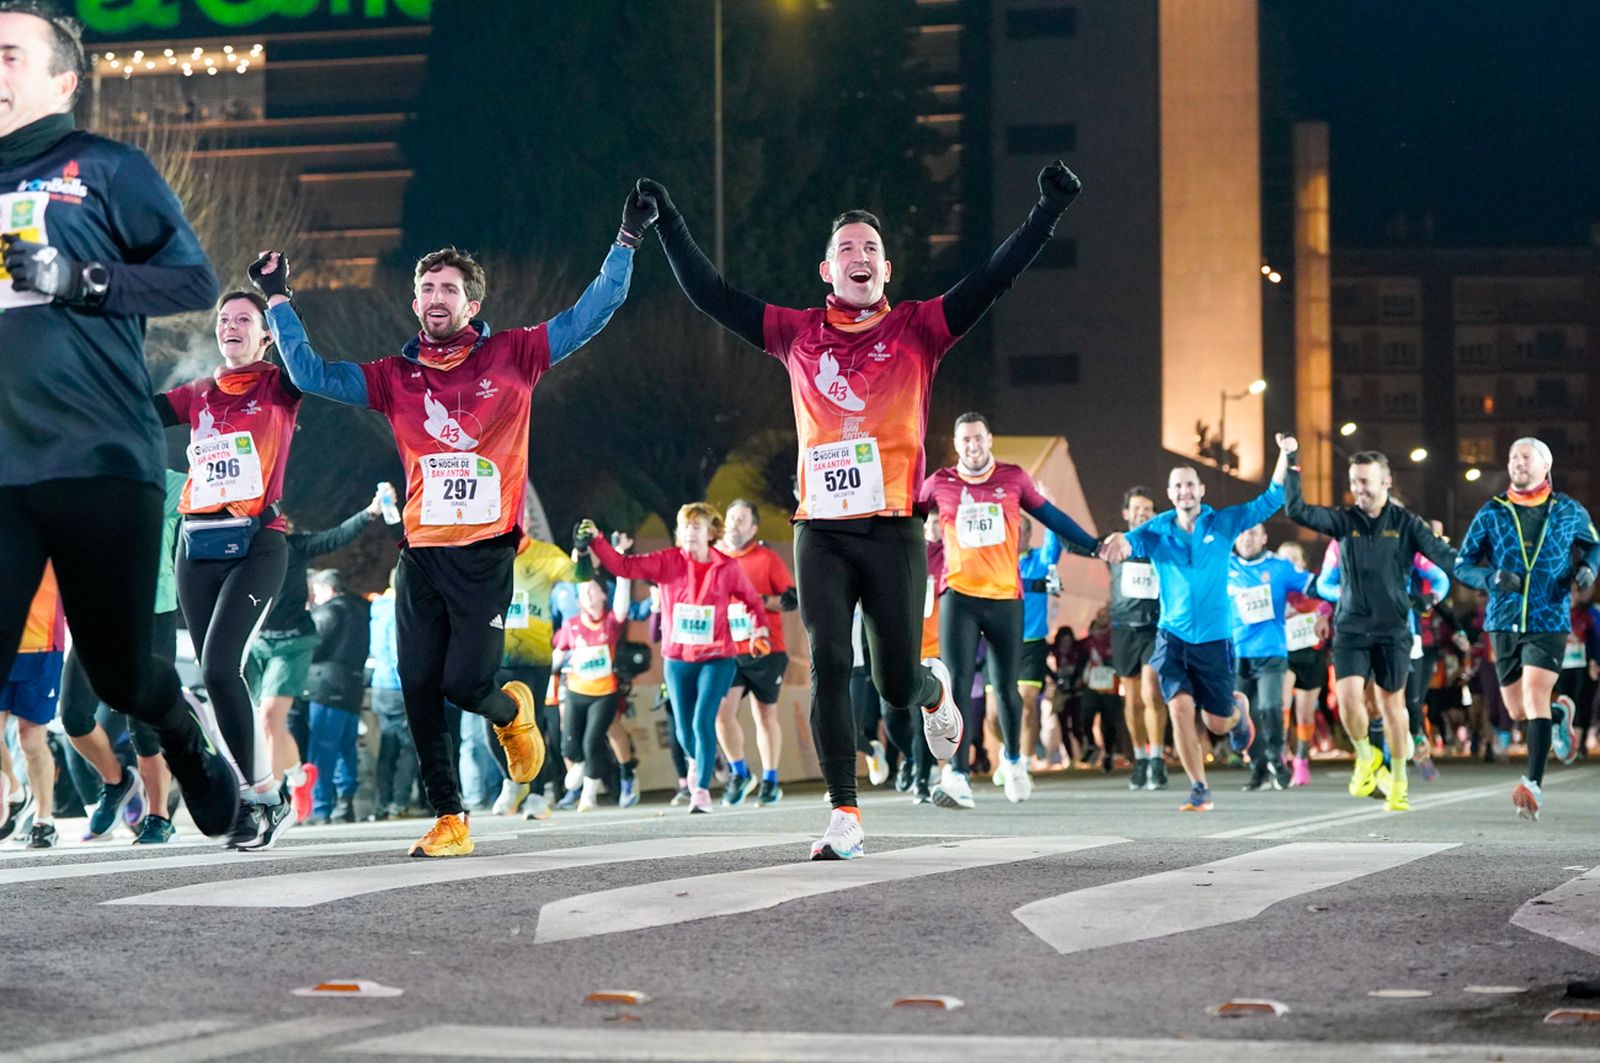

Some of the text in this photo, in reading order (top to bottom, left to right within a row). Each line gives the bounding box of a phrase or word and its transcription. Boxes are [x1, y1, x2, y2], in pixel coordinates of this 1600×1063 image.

[828, 381, 848, 402] 43
[440, 424, 460, 443] 43
[460, 460, 470, 468] DE
[820, 450, 840, 460] NOCHE
[841, 449, 850, 457] DE
[206, 458, 241, 482] 296
[824, 467, 861, 492] 520
[443, 478, 478, 500] 297
